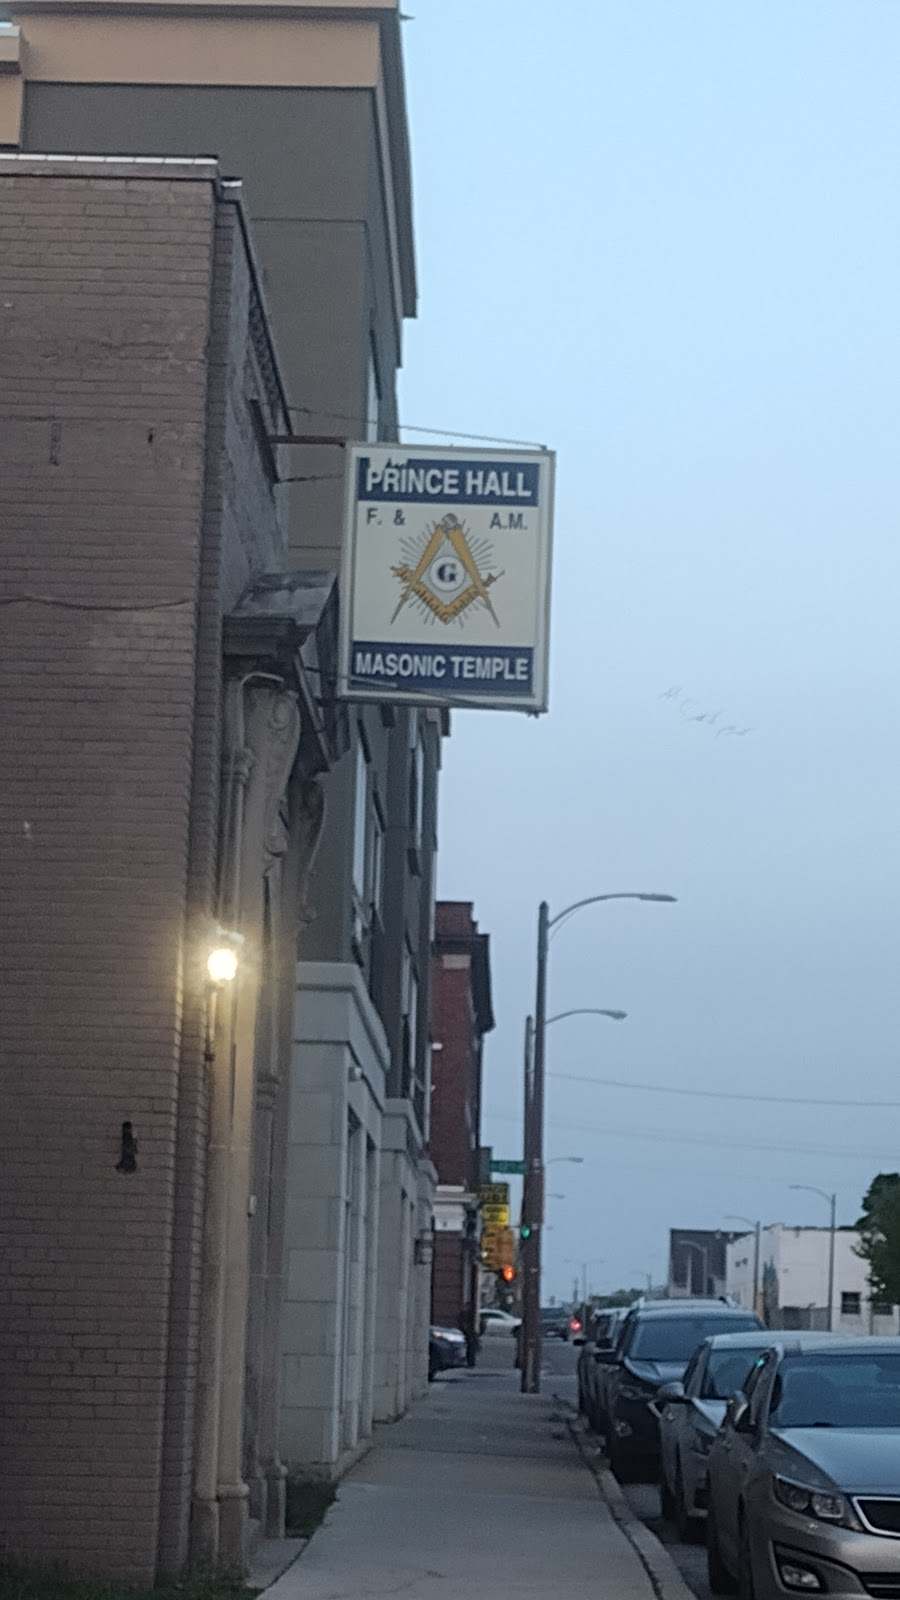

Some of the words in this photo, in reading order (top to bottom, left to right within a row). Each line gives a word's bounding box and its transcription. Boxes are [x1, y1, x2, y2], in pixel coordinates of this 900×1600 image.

[366, 468, 459, 494] PRINCE
[465, 472, 532, 497] HALL
[366, 508, 383, 526] F.
[393, 509, 405, 526] &
[489, 512, 528, 531] A.M.
[437, 563, 456, 583] G
[355, 652, 446, 677] MASONIC
[451, 656, 529, 681] TEMPLE
